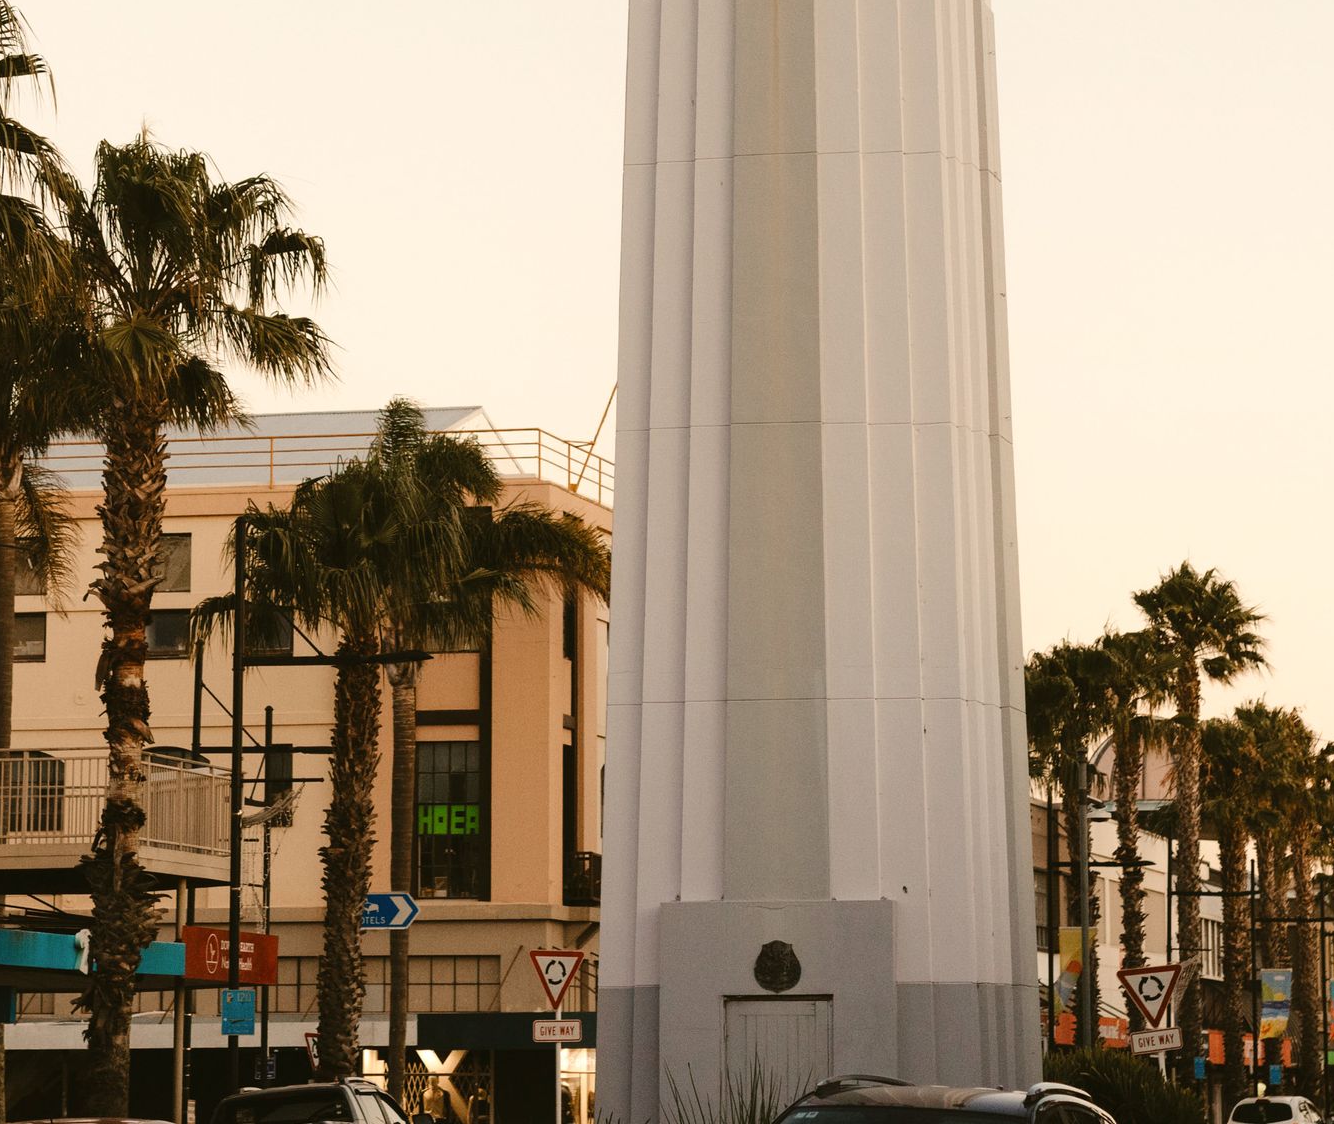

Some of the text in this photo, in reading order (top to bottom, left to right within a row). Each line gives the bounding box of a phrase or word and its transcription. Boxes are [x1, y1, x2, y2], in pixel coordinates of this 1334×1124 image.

[540, 1026, 575, 1036] GIVE WAY
[1138, 1034, 1175, 1048] GIVE WAY
